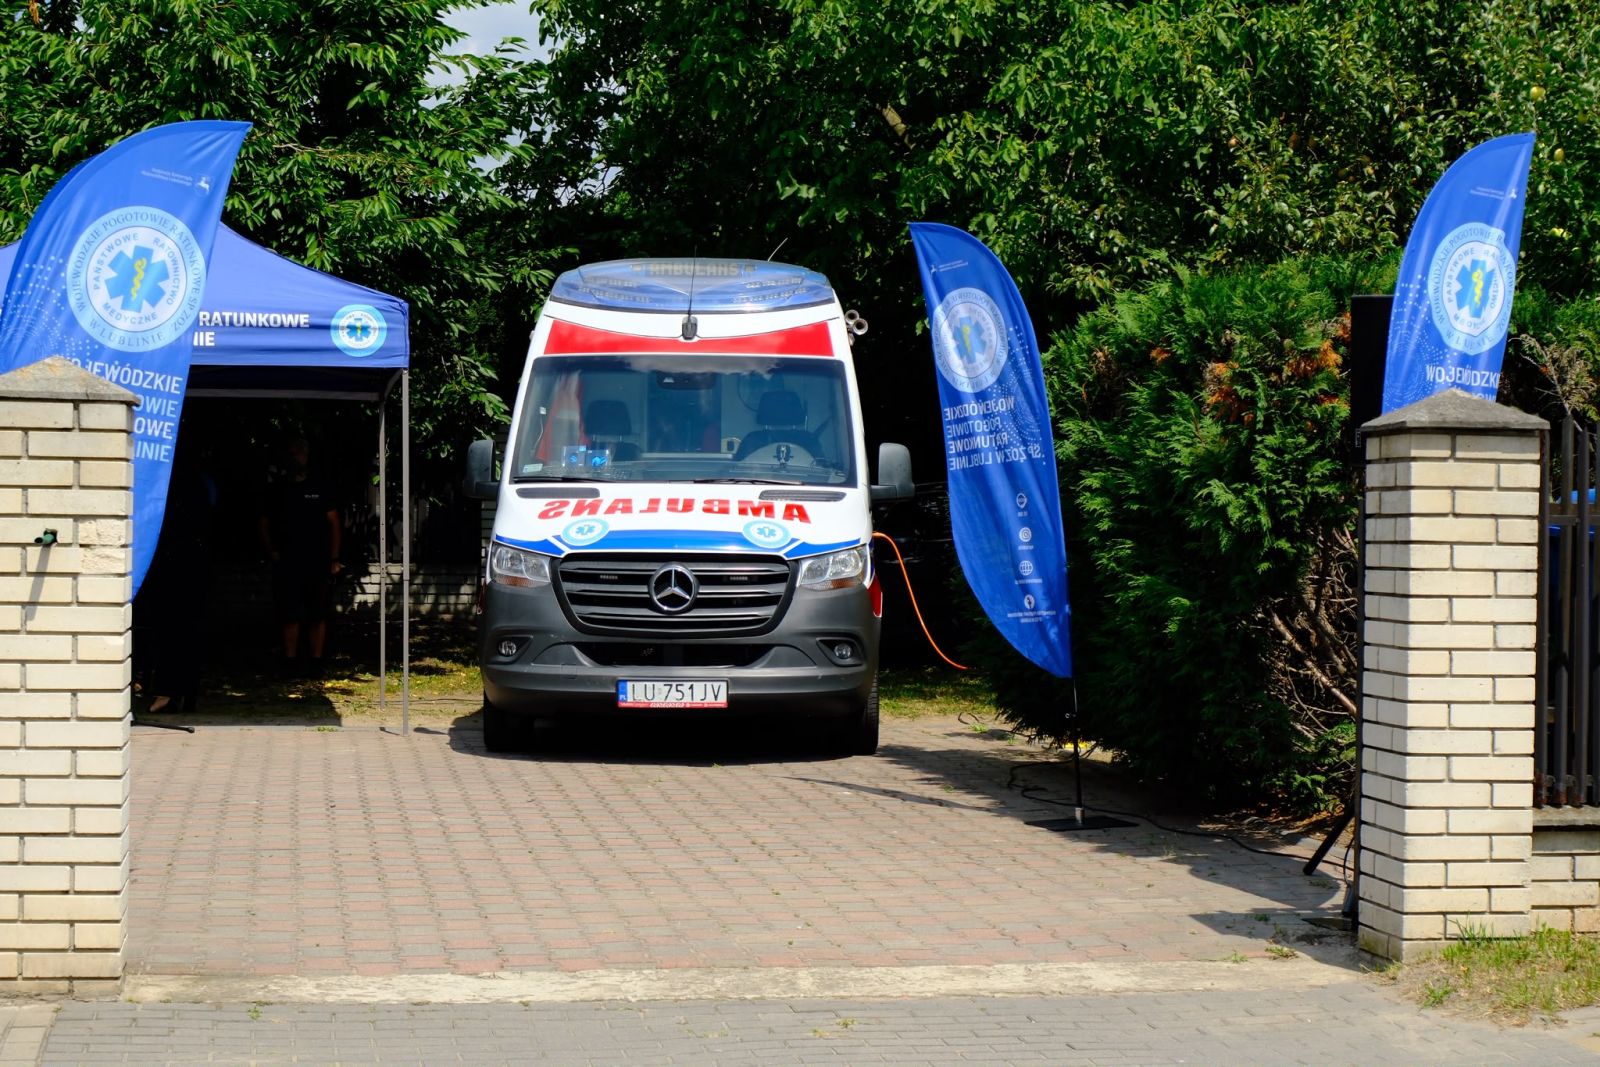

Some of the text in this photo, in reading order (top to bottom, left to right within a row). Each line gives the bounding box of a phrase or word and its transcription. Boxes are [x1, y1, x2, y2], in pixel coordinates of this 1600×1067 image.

[102, 211, 170, 231] POGOTOWIE
[169, 223, 201, 294] RATUNKOWE
[103, 302, 158, 325] MEDYCZNE
[199, 311, 310, 328] RATUNKOWE
[99, 328, 165, 347] LUBLINIE
[66, 357, 183, 394] OJEWÓDZKIE
[132, 394, 178, 418] OWIE
[134, 416, 175, 440] OWE
[136, 440, 172, 463] INIE
[632, 683, 721, 702] LU 751JV
